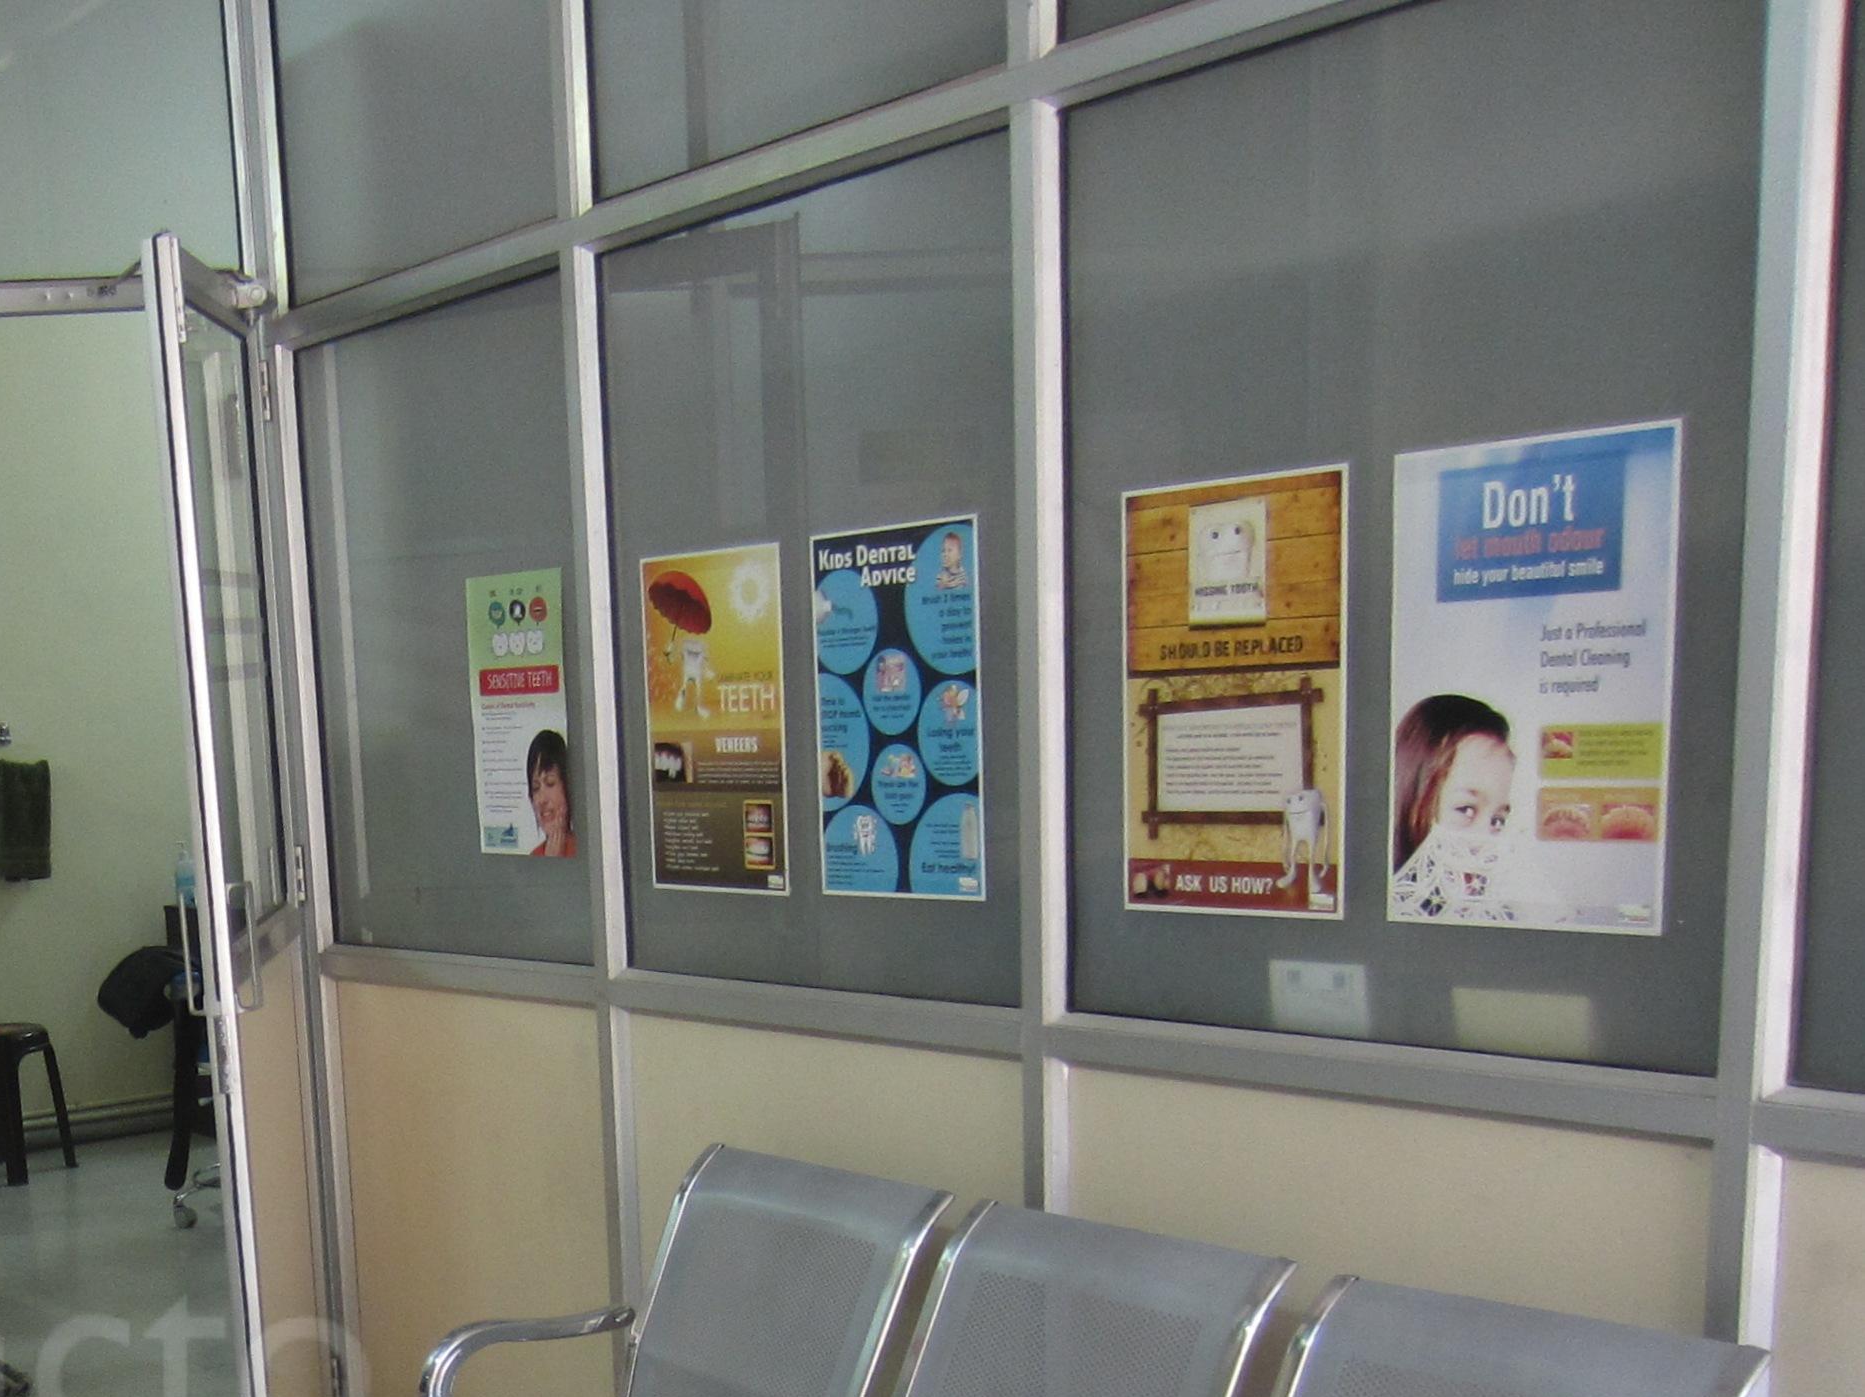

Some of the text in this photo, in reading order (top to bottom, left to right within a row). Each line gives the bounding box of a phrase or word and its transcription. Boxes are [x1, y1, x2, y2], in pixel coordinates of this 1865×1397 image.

[1483, 474, 1576, 529] Don't
[1453, 558, 1604, 586] hide your beautiful smile
[1540, 619, 1647, 641] Just a Professional
[1160, 635, 1304, 660] SHOULD BE REPLACED
[1540, 648, 1631, 668] Dental Cleaning
[528, 669, 553, 688] TEETH
[1551, 675, 1600, 696] required
[717, 683, 775, 713] TEETH
[715, 736, 759, 753] VENEERS
[1174, 874, 1273, 895] ASK US HOW?
